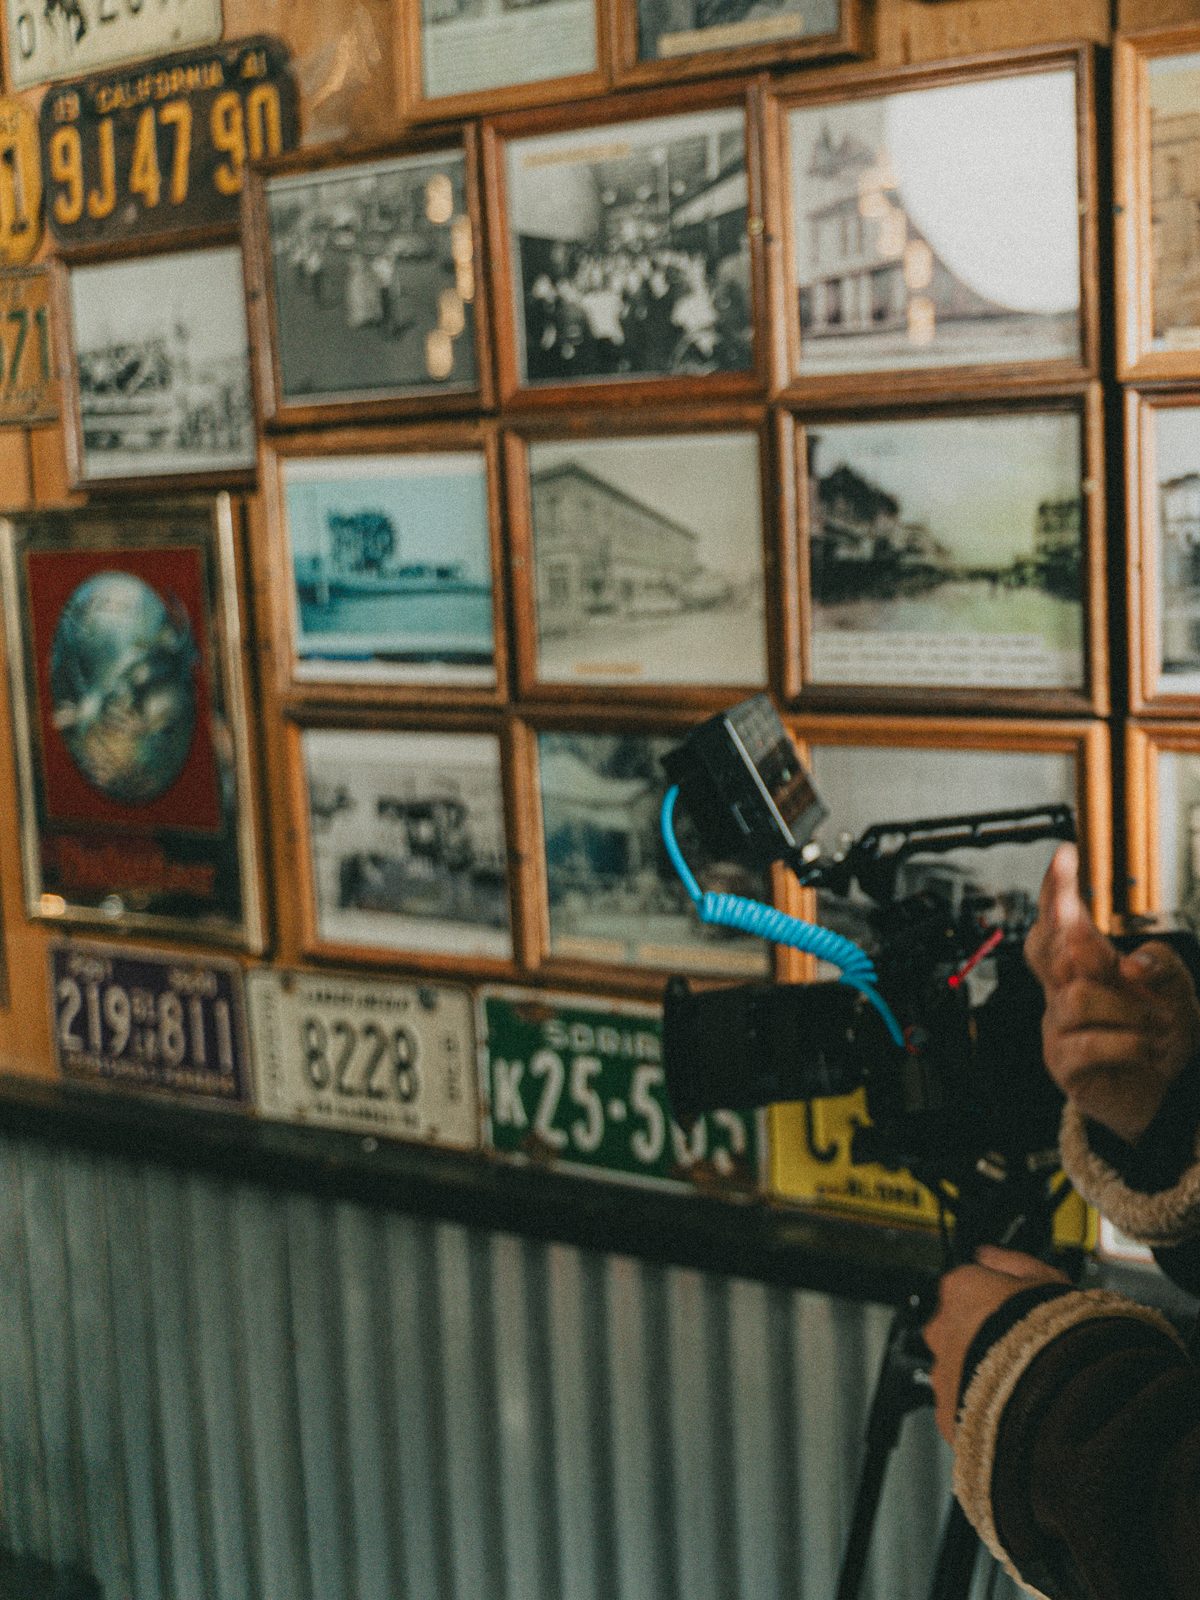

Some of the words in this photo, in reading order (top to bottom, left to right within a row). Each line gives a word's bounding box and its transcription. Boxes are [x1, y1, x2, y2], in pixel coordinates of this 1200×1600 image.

[96, 60, 224, 114] CALIFORNIA
[58, 977, 131, 1058] 219
[158, 990, 234, 1074] 811
[304, 1015, 421, 1104] 8228
